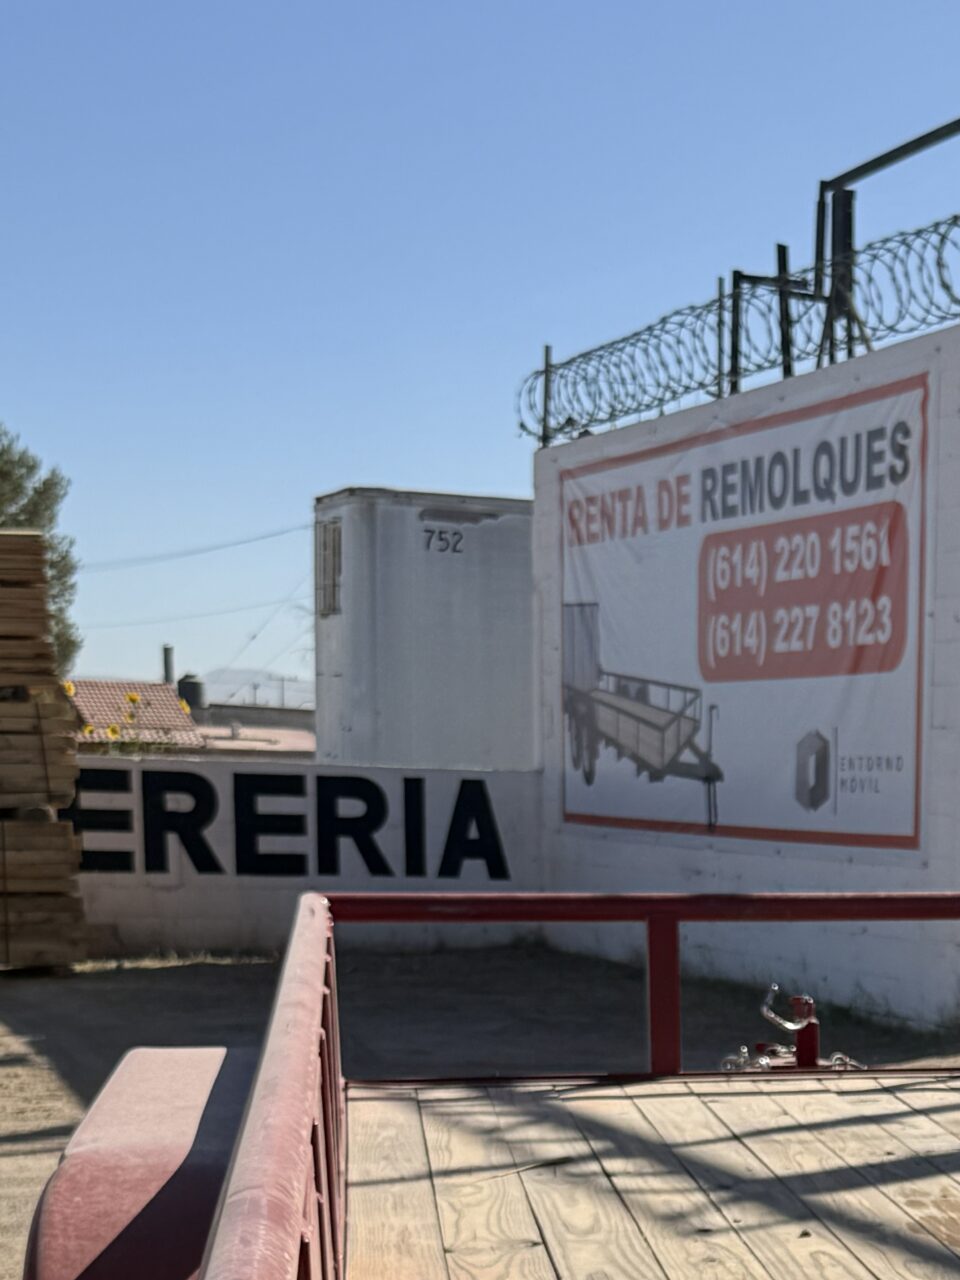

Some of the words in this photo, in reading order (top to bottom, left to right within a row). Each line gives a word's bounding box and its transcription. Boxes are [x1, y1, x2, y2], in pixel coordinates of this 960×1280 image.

[568, 484, 648, 546] RENTA
[657, 474, 692, 532] DE
[701, 421, 912, 523] REMOLQUES
[423, 529, 465, 554] 752
[707, 539, 768, 603] (614)
[774, 532, 821, 584] 220
[830, 517, 891, 575] 1561
[707, 609, 767, 670] (614)
[773, 604, 820, 654] 227
[826, 596, 893, 650] 8123
[839, 755, 904, 772] ENTORNO
